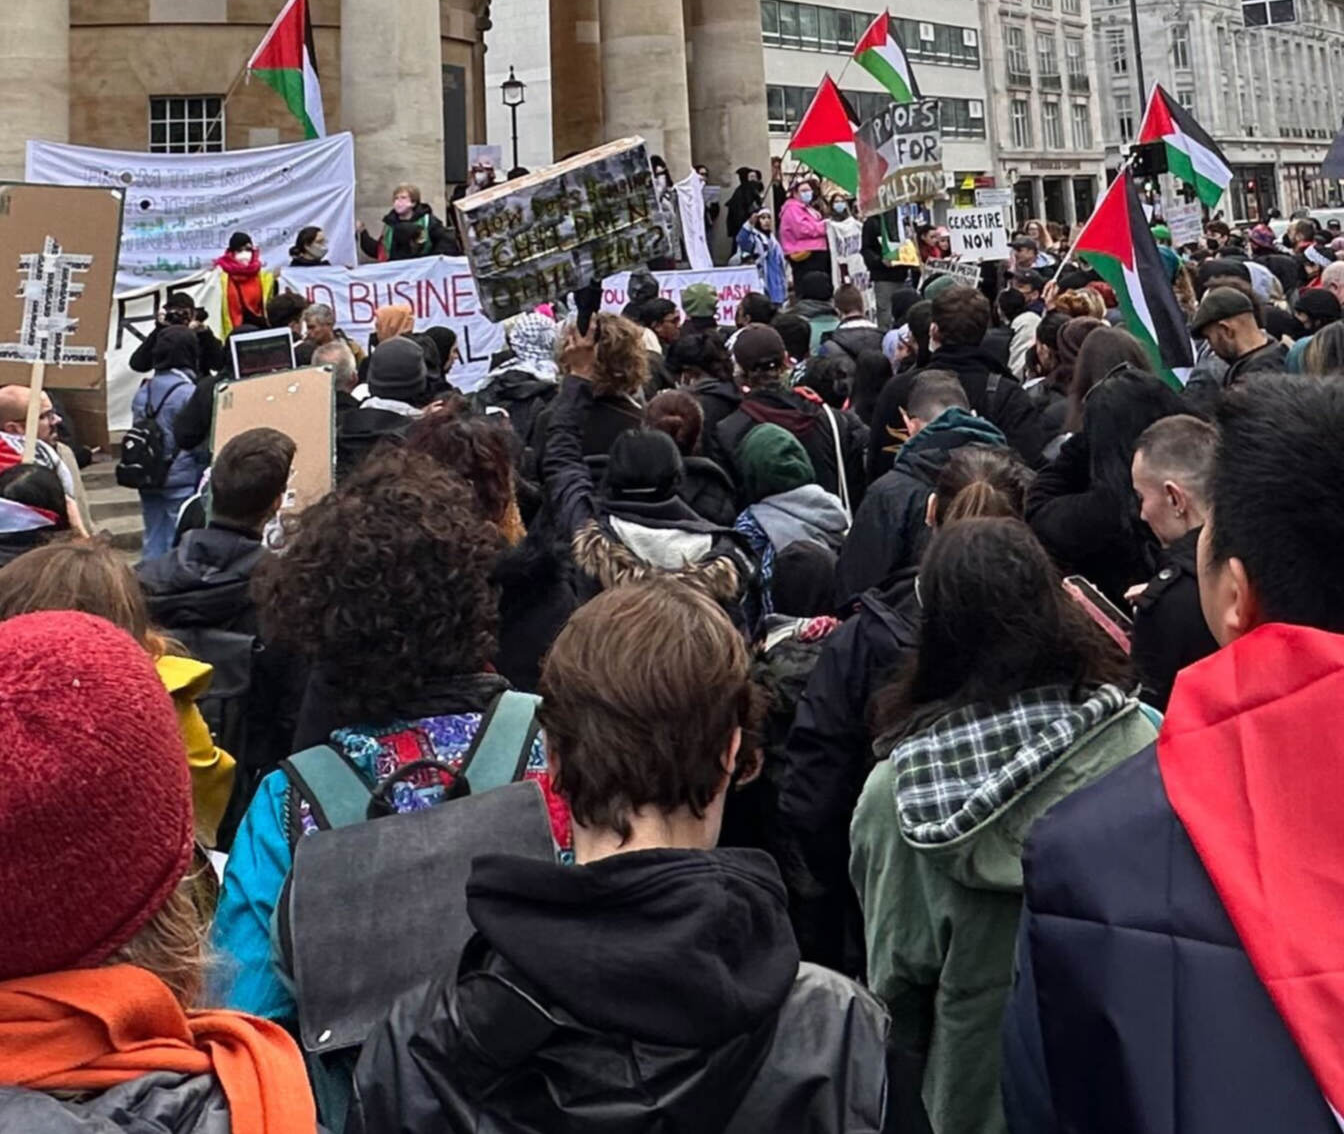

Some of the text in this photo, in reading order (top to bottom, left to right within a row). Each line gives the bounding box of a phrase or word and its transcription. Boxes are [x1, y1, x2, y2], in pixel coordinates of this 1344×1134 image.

[897, 134, 938, 165] FOR
[948, 211, 1004, 230] CEASEFIRE
[962, 232, 994, 249] NOW
[348, 273, 477, 324] BUSINE
[602, 289, 625, 305] OU
